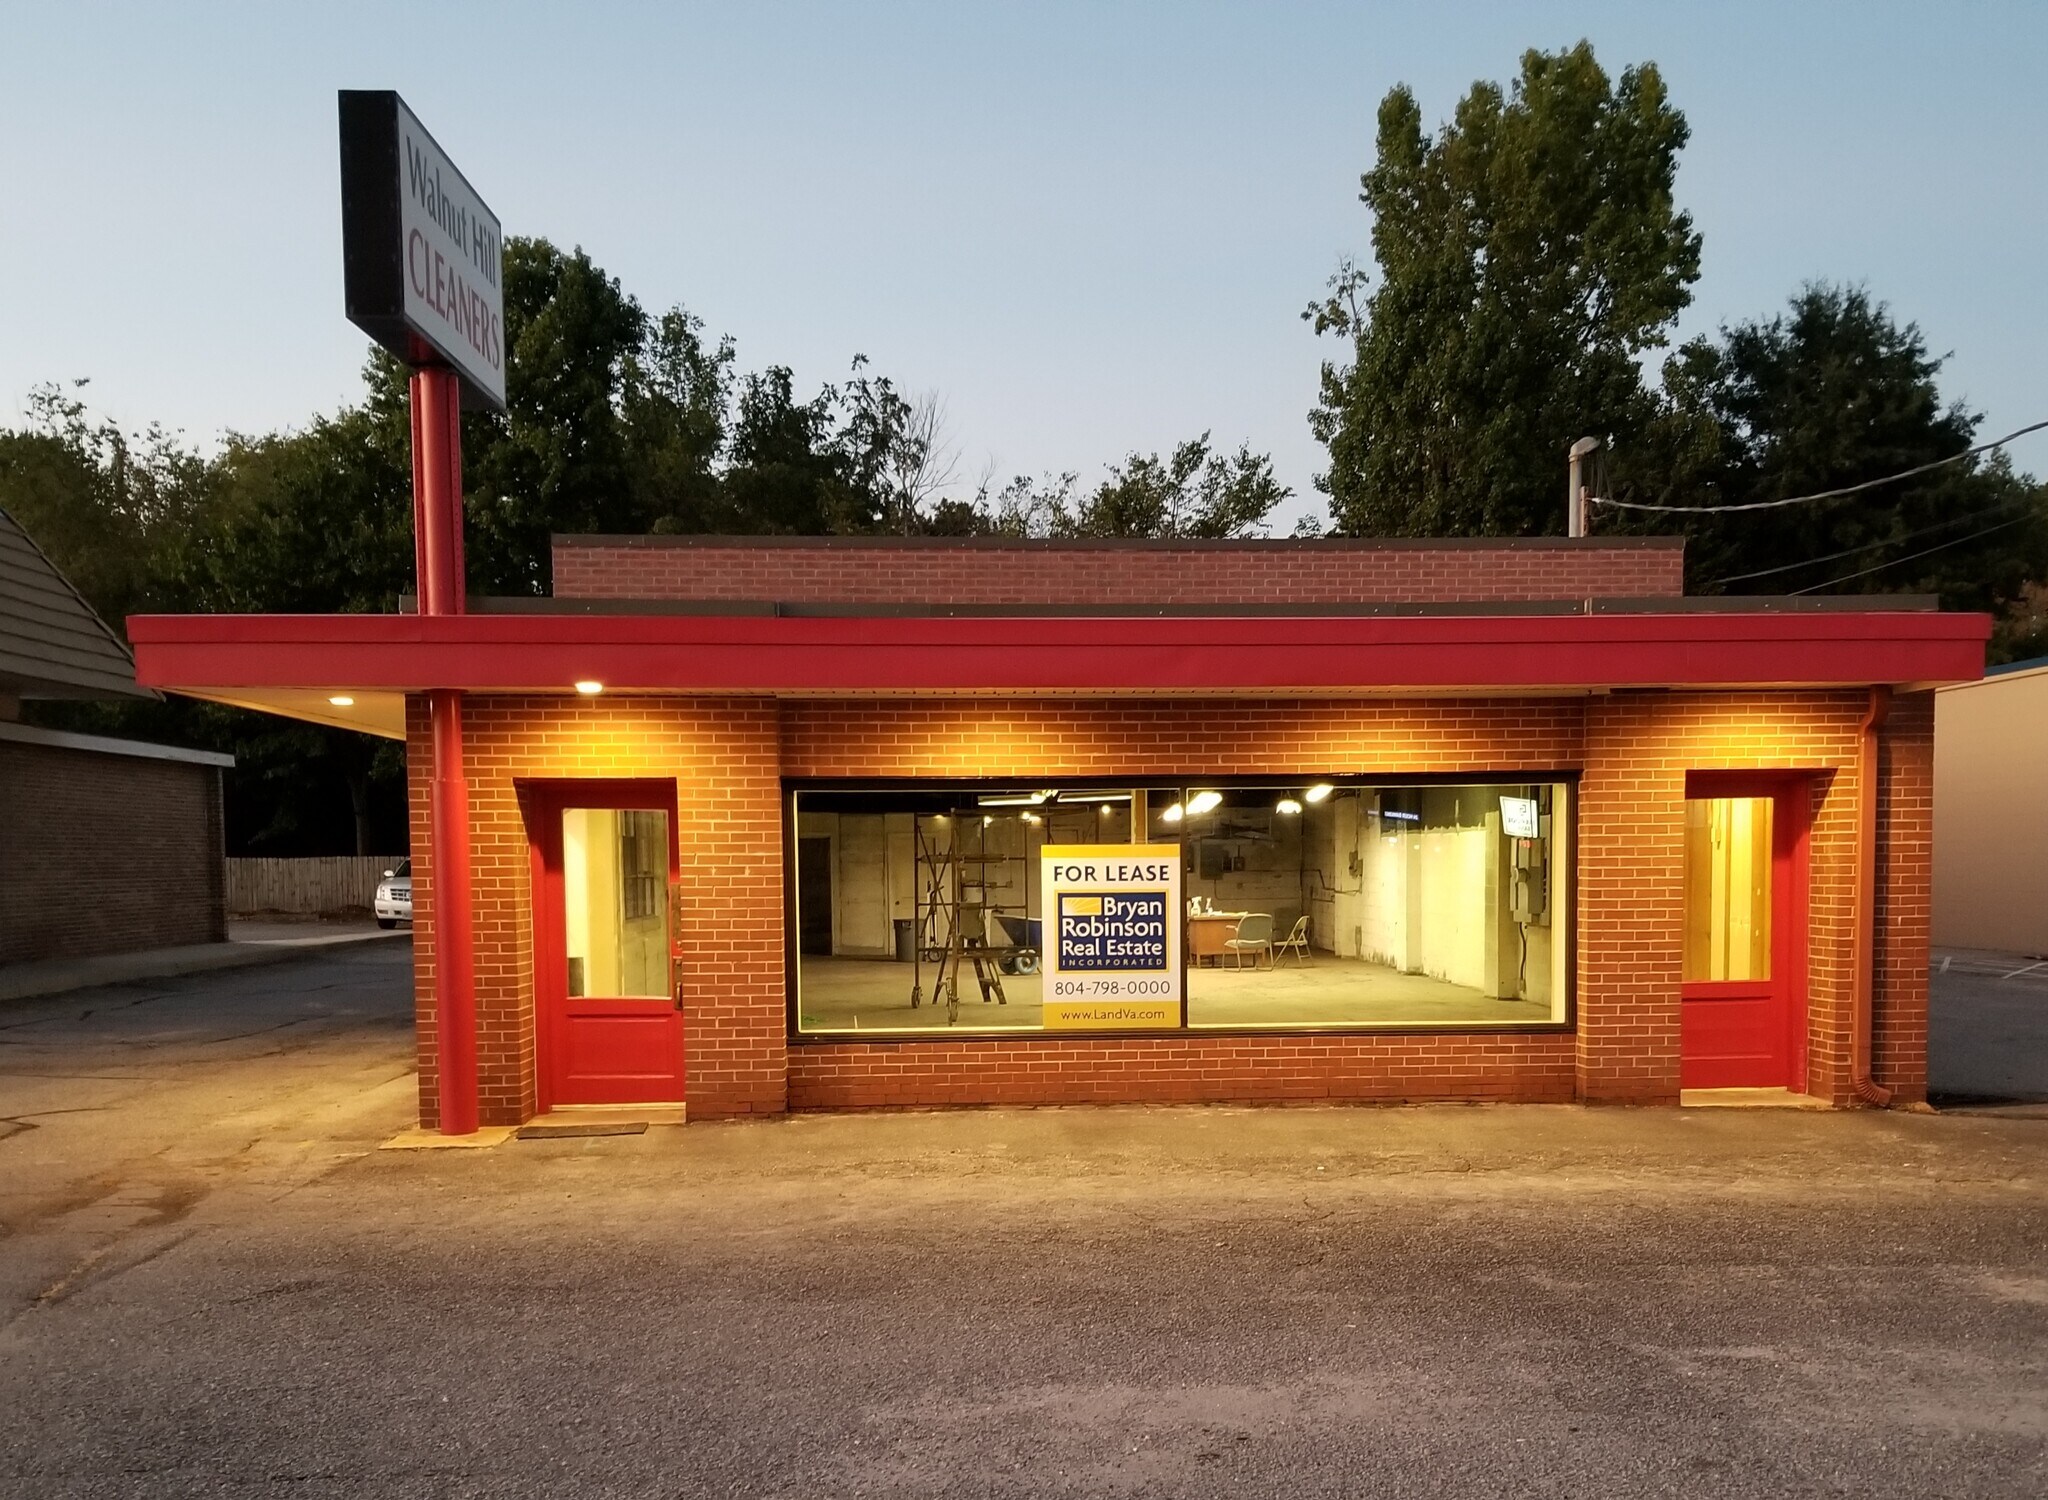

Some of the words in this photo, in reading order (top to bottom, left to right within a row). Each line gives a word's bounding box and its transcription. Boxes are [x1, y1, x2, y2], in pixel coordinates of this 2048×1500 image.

[406, 134, 468, 258] Walnut
[471, 213, 496, 289] Hill
[408, 227, 500, 370] CLEANERS
[1053, 865, 1098, 882] FOR
[1105, 865, 1170, 882] LEASE
[1103, 896, 1162, 921] Bryan
[1062, 916, 1163, 937] Robinson
[1062, 938, 1101, 956] Real
[1106, 939, 1163, 956] Estate
[1062, 958, 1163, 966] INCORPORATED
[1055, 980, 1171, 996] 804-798-0000
[1061, 1008, 1165, 1021] www.LandVa.com
